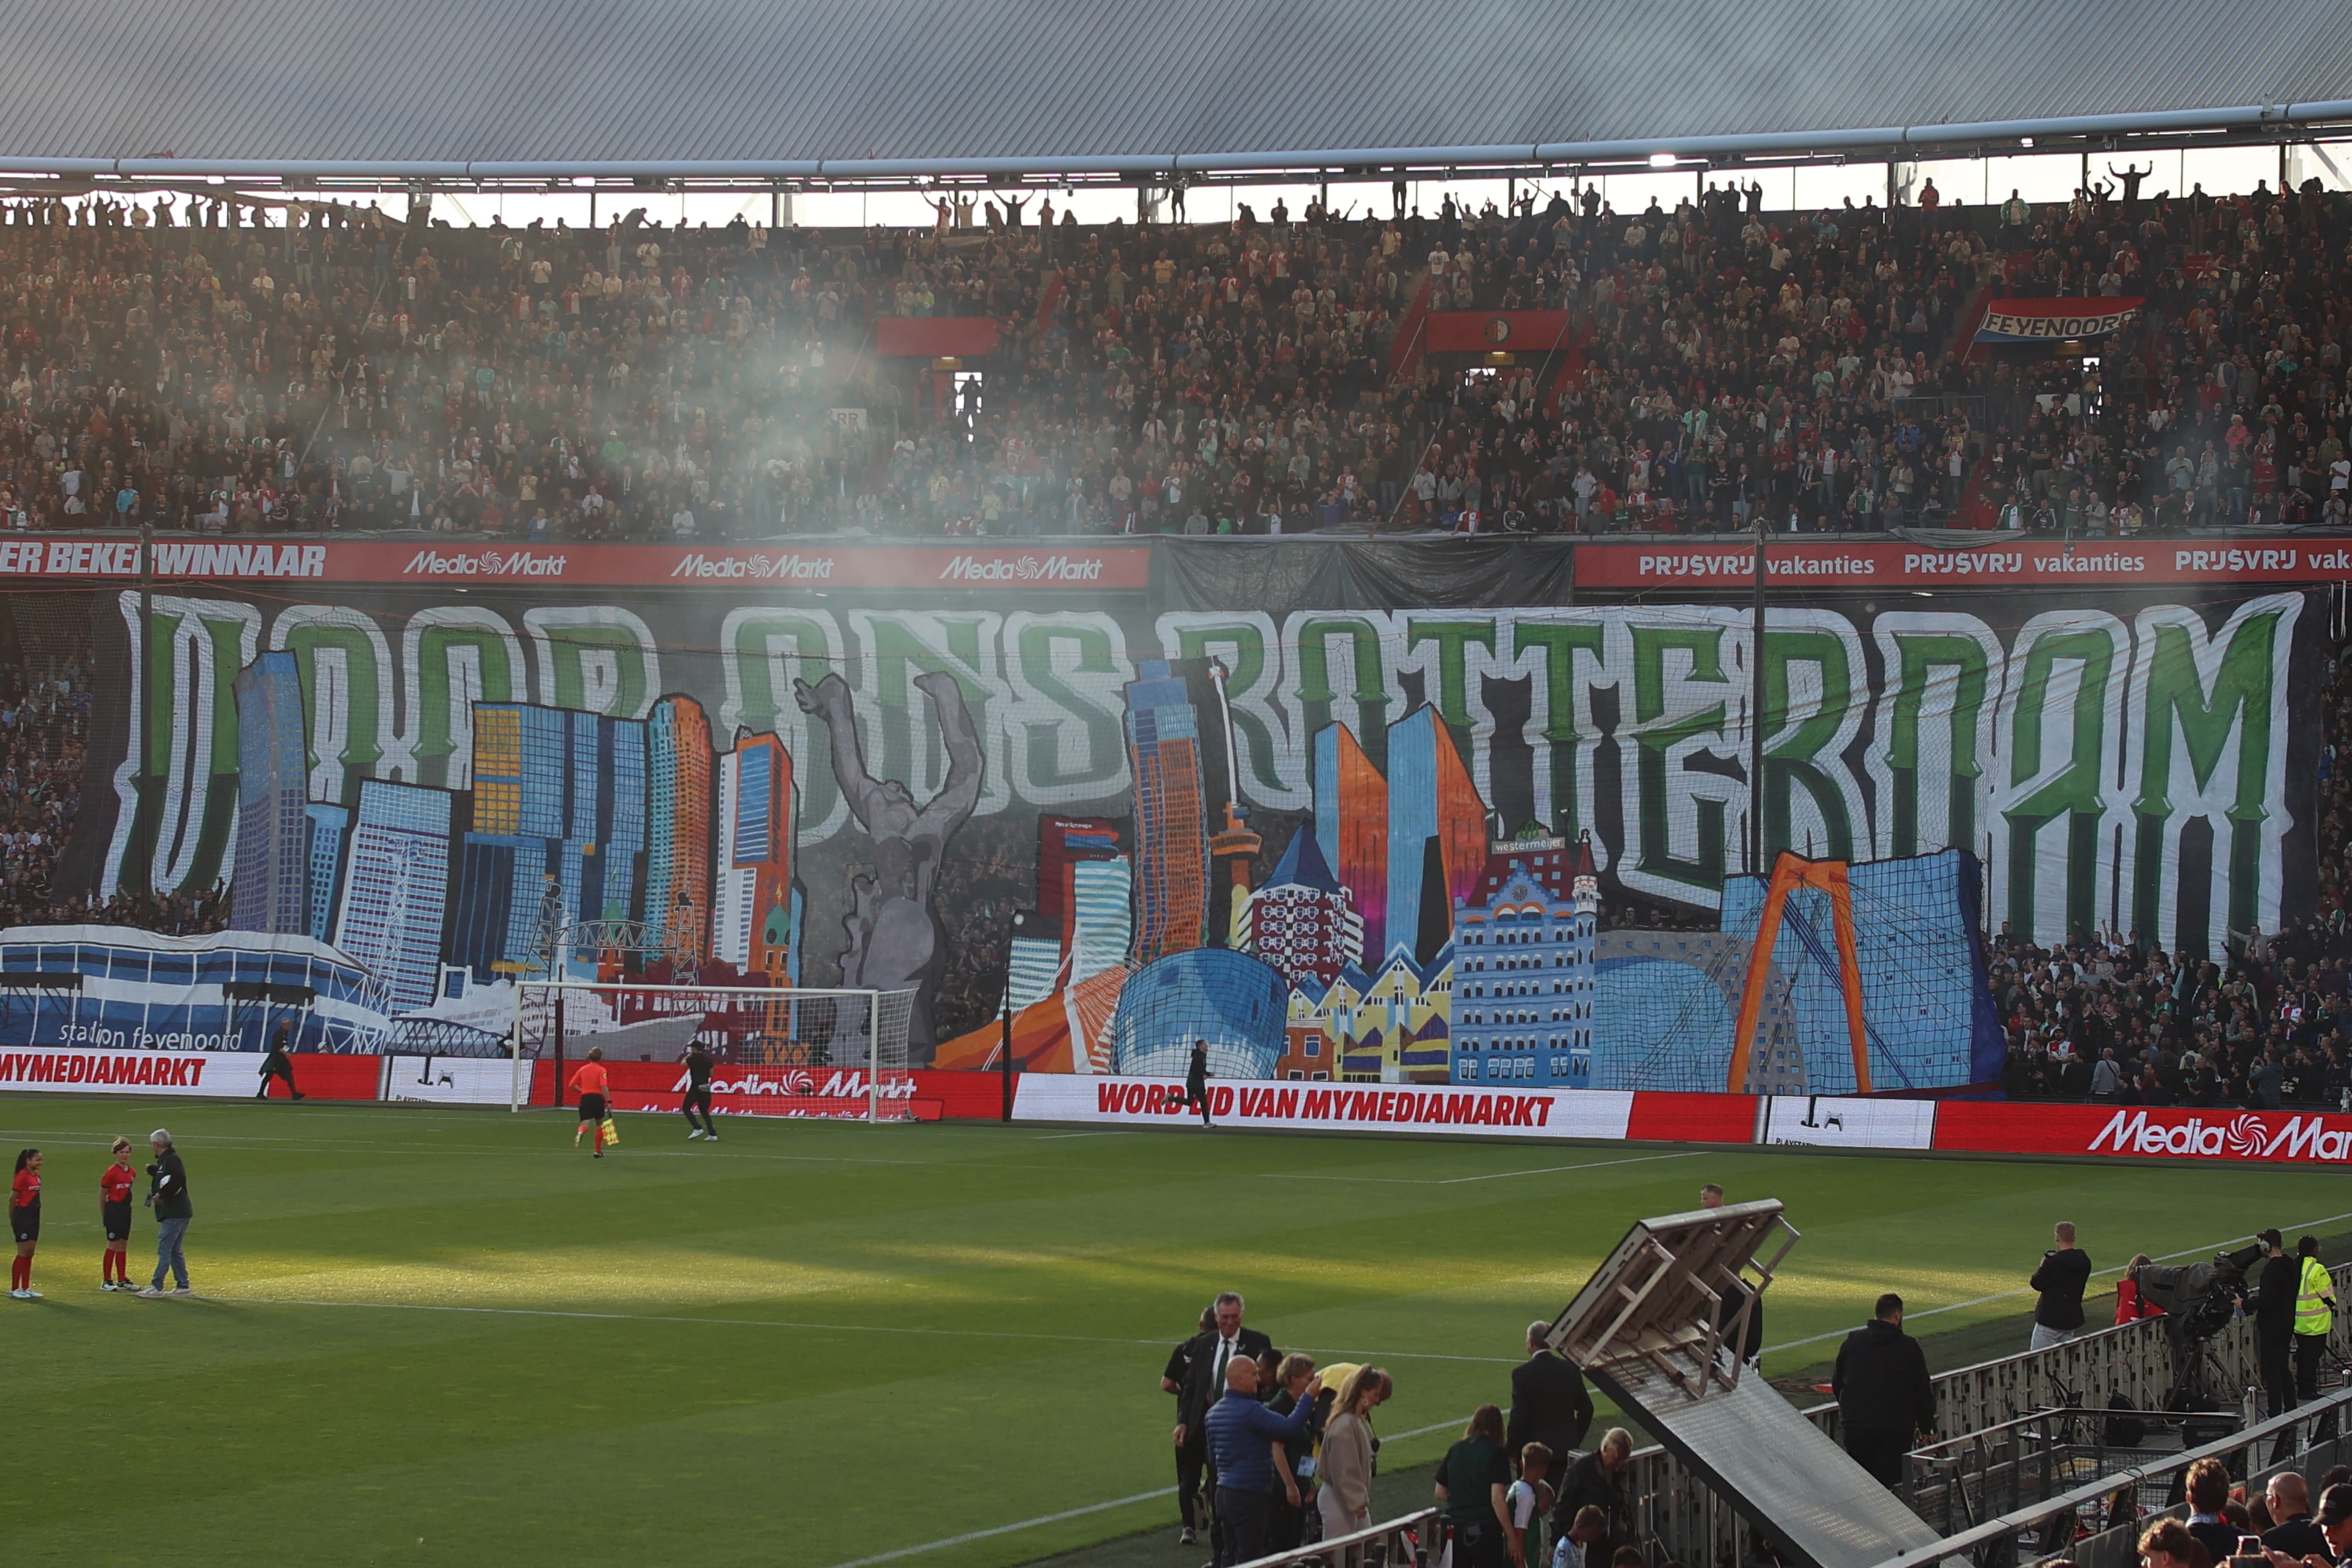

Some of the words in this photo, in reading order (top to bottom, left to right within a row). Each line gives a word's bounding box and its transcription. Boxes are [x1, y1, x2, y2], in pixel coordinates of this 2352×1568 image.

[1985, 311, 2134, 337] FEYENOORD
[0, 541, 43, 573] ER
[403, 551, 478, 574] Media
[498, 552, 566, 575] Markt
[671, 554, 746, 577] Media
[766, 555, 834, 577] Markt
[939, 556, 1015, 579] Media
[1034, 556, 1102, 579] Markt
[1766, 555, 1874, 574] vakanties
[2034, 552, 2144, 572] vakanties
[2308, 549, 2352, 569] vak
[720, 607, 1137, 848] ONS
[1155, 590, 2305, 969] ROTTERDAM
[1496, 838, 1561, 851] westermeijer
[1098, 1083, 1185, 1115] WORD
[1239, 1087, 1299, 1118] VAN
[1301, 1088, 1555, 1127] MYMEDIAMARKT
[2087, 1110, 2226, 1155] Media
